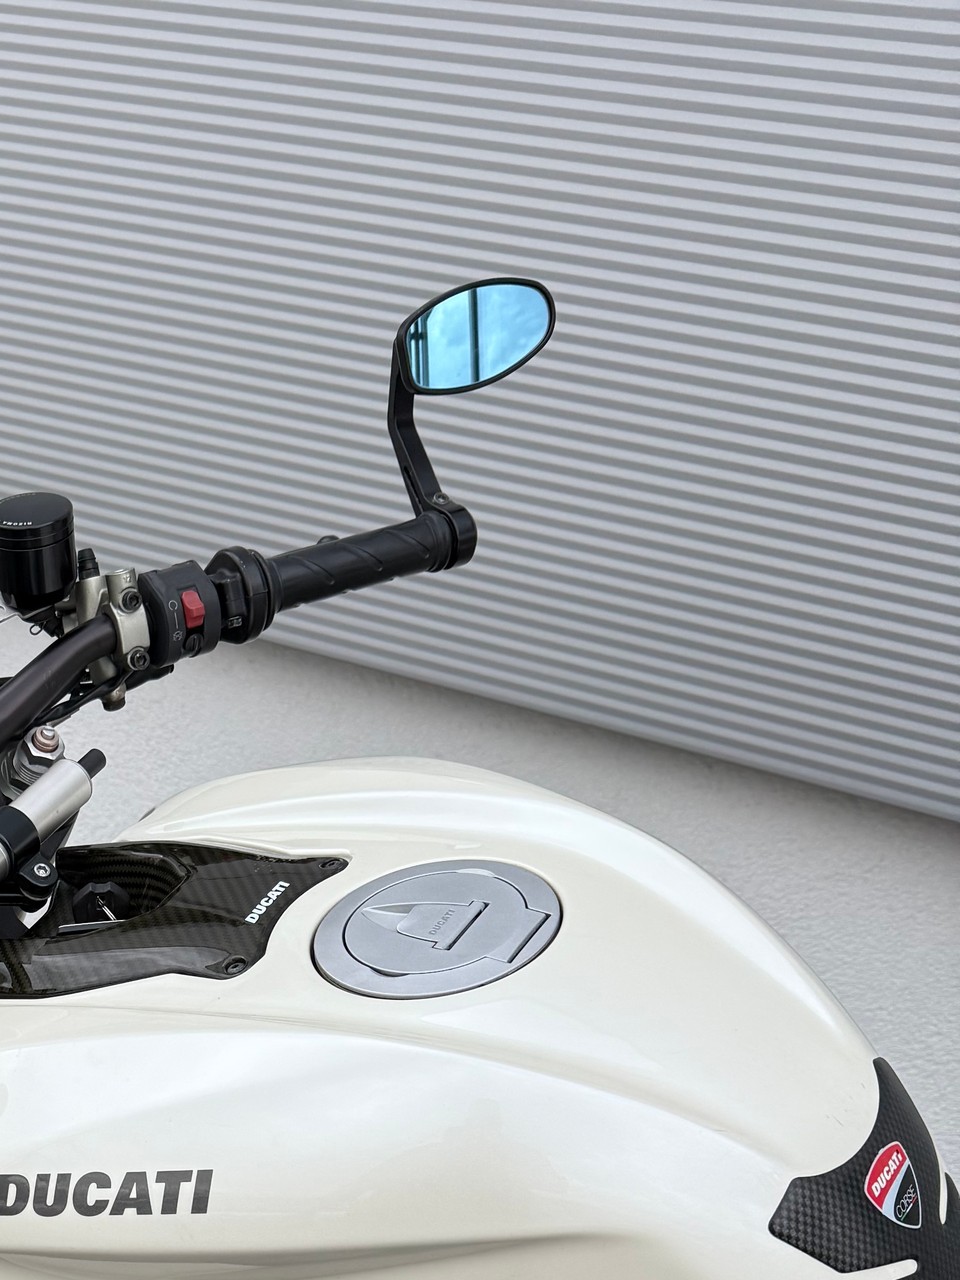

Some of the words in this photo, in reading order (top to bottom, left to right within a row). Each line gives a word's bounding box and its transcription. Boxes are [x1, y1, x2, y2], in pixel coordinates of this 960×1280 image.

[244, 880, 291, 924] DUCATI
[428, 908, 456, 935] DUCATI
[871, 1151, 903, 1197] DUCATI
[895, 1183, 916, 1218] CORSE
